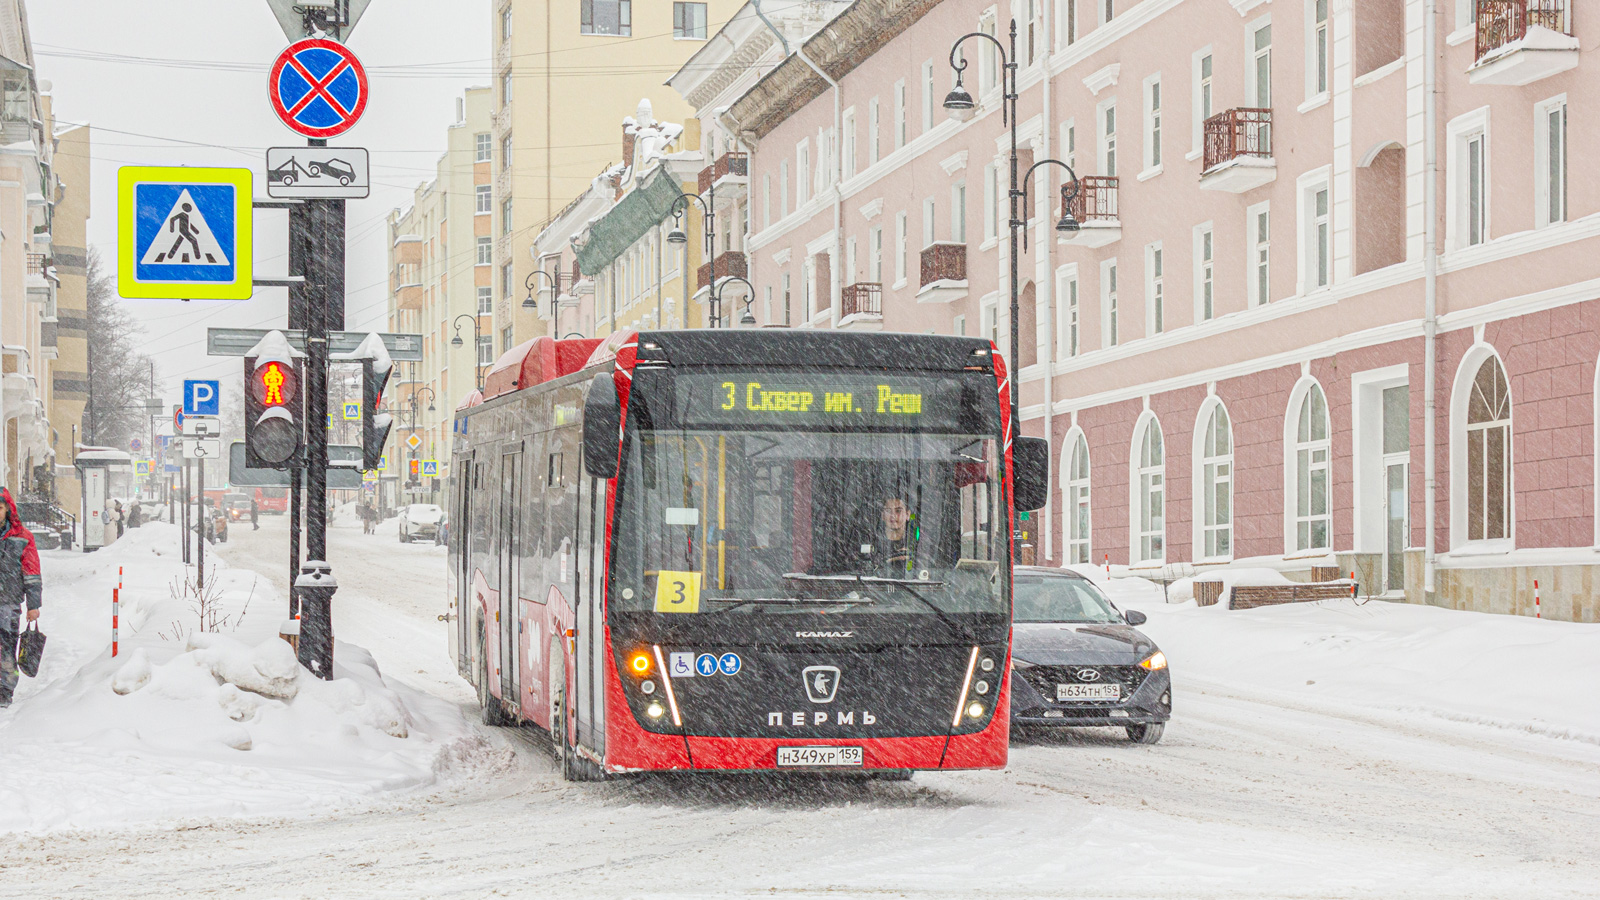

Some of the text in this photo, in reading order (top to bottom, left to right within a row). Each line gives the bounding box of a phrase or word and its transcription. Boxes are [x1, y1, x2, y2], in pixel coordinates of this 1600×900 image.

[193, 383, 214, 412] P
[721, 382, 735, 411] 3
[746, 382, 813, 412] Сквер
[824, 392, 862, 413] им.
[670, 581, 686, 604] 3
[768, 711, 877, 726] ПЕРМЬ
[838, 748, 859, 760] 159
